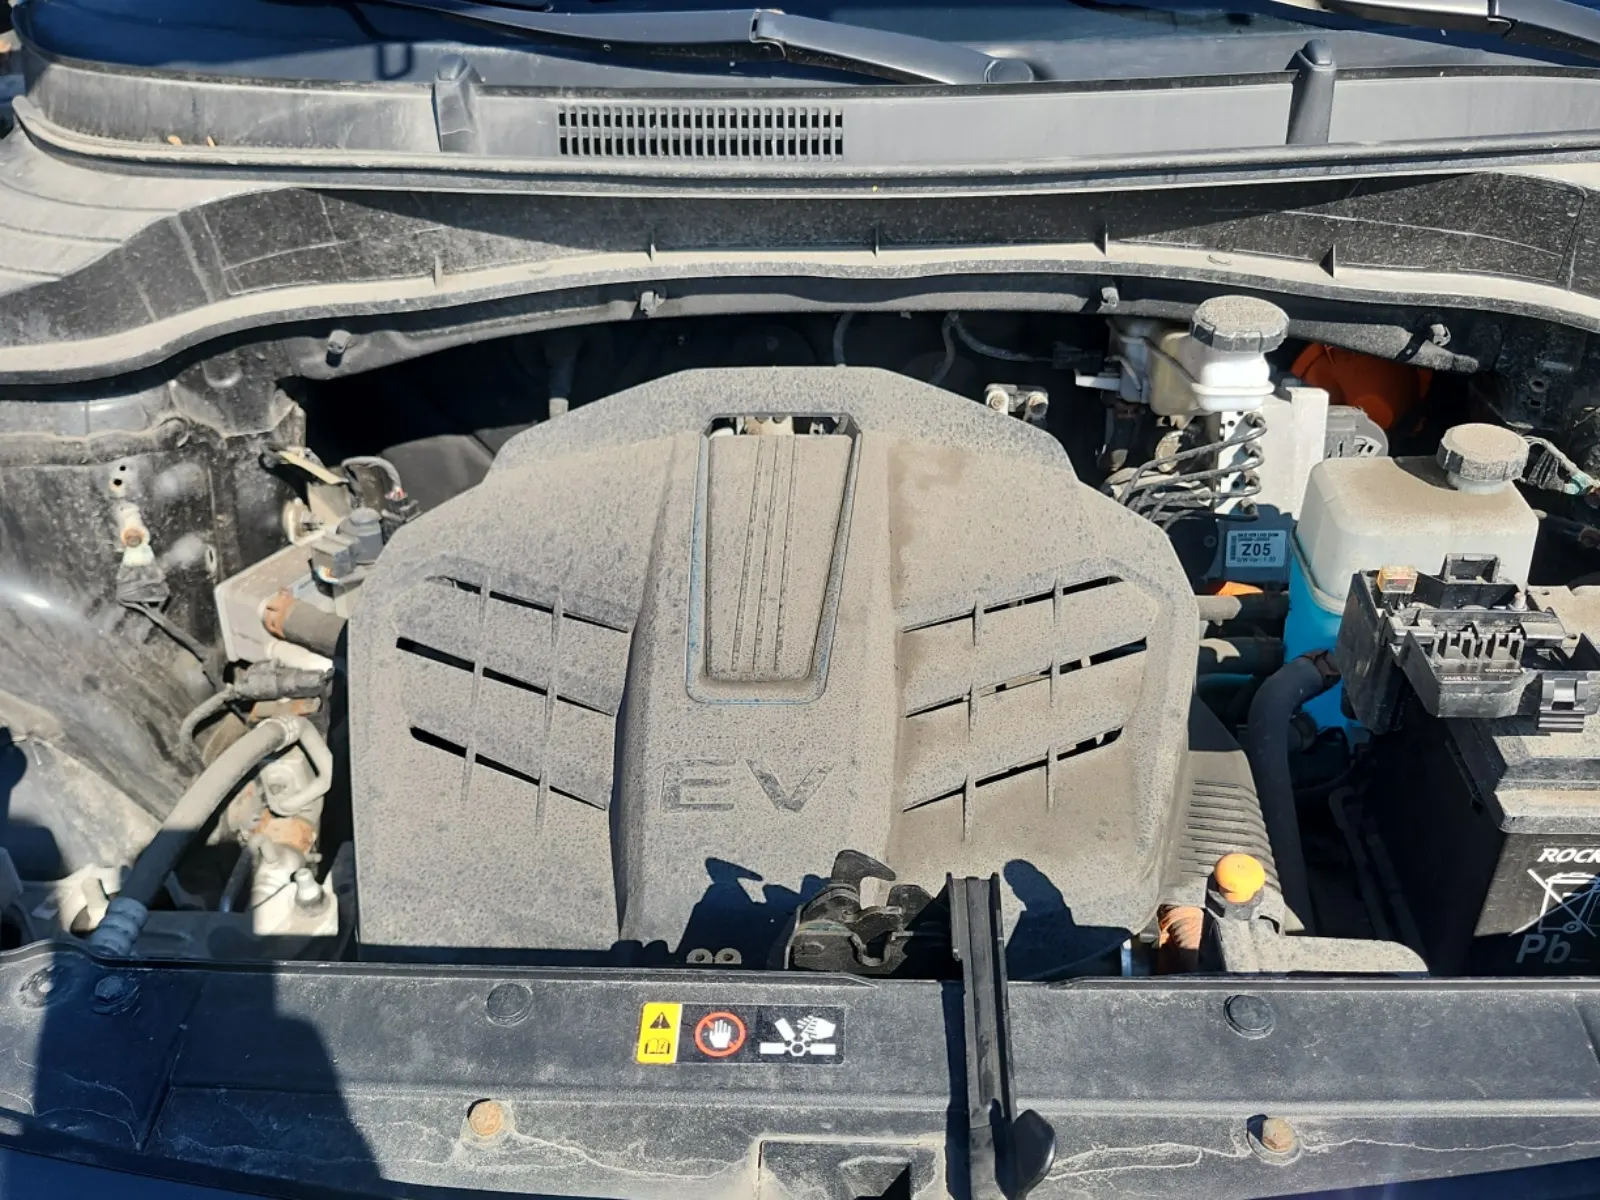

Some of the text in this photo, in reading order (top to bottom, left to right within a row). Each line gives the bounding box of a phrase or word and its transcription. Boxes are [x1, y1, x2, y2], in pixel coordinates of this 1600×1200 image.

[1241, 543, 1271, 556] Z05
[660, 759, 834, 813] EV
[1515, 933, 1571, 964] Pb
